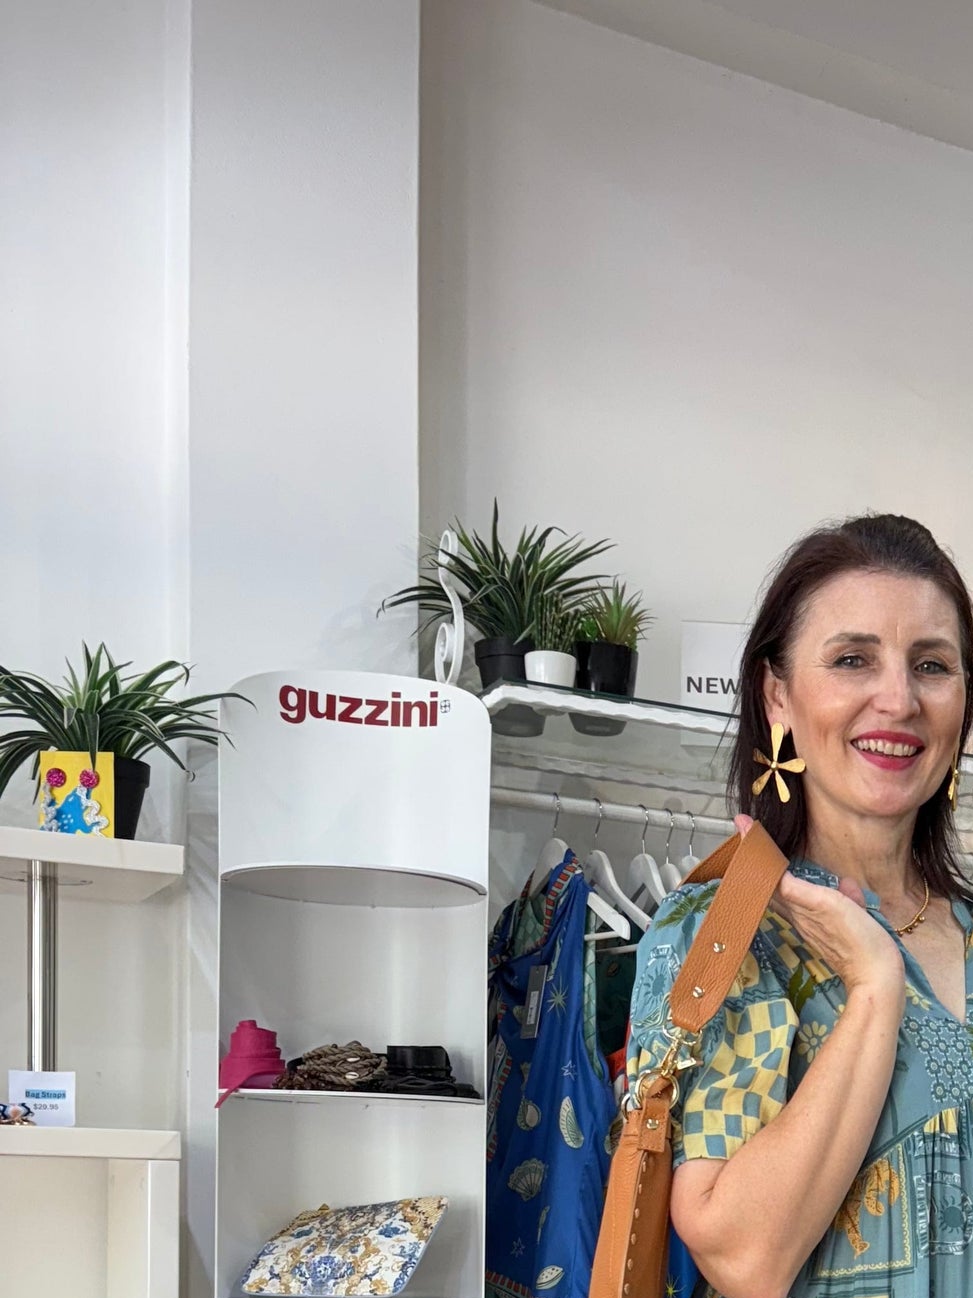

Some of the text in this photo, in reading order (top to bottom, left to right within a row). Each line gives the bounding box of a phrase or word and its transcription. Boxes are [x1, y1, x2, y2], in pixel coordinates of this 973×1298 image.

[686, 676, 741, 695] NEW
[279, 684, 439, 727] guzzini
[25, 1090, 66, 1100] Bag Straps
